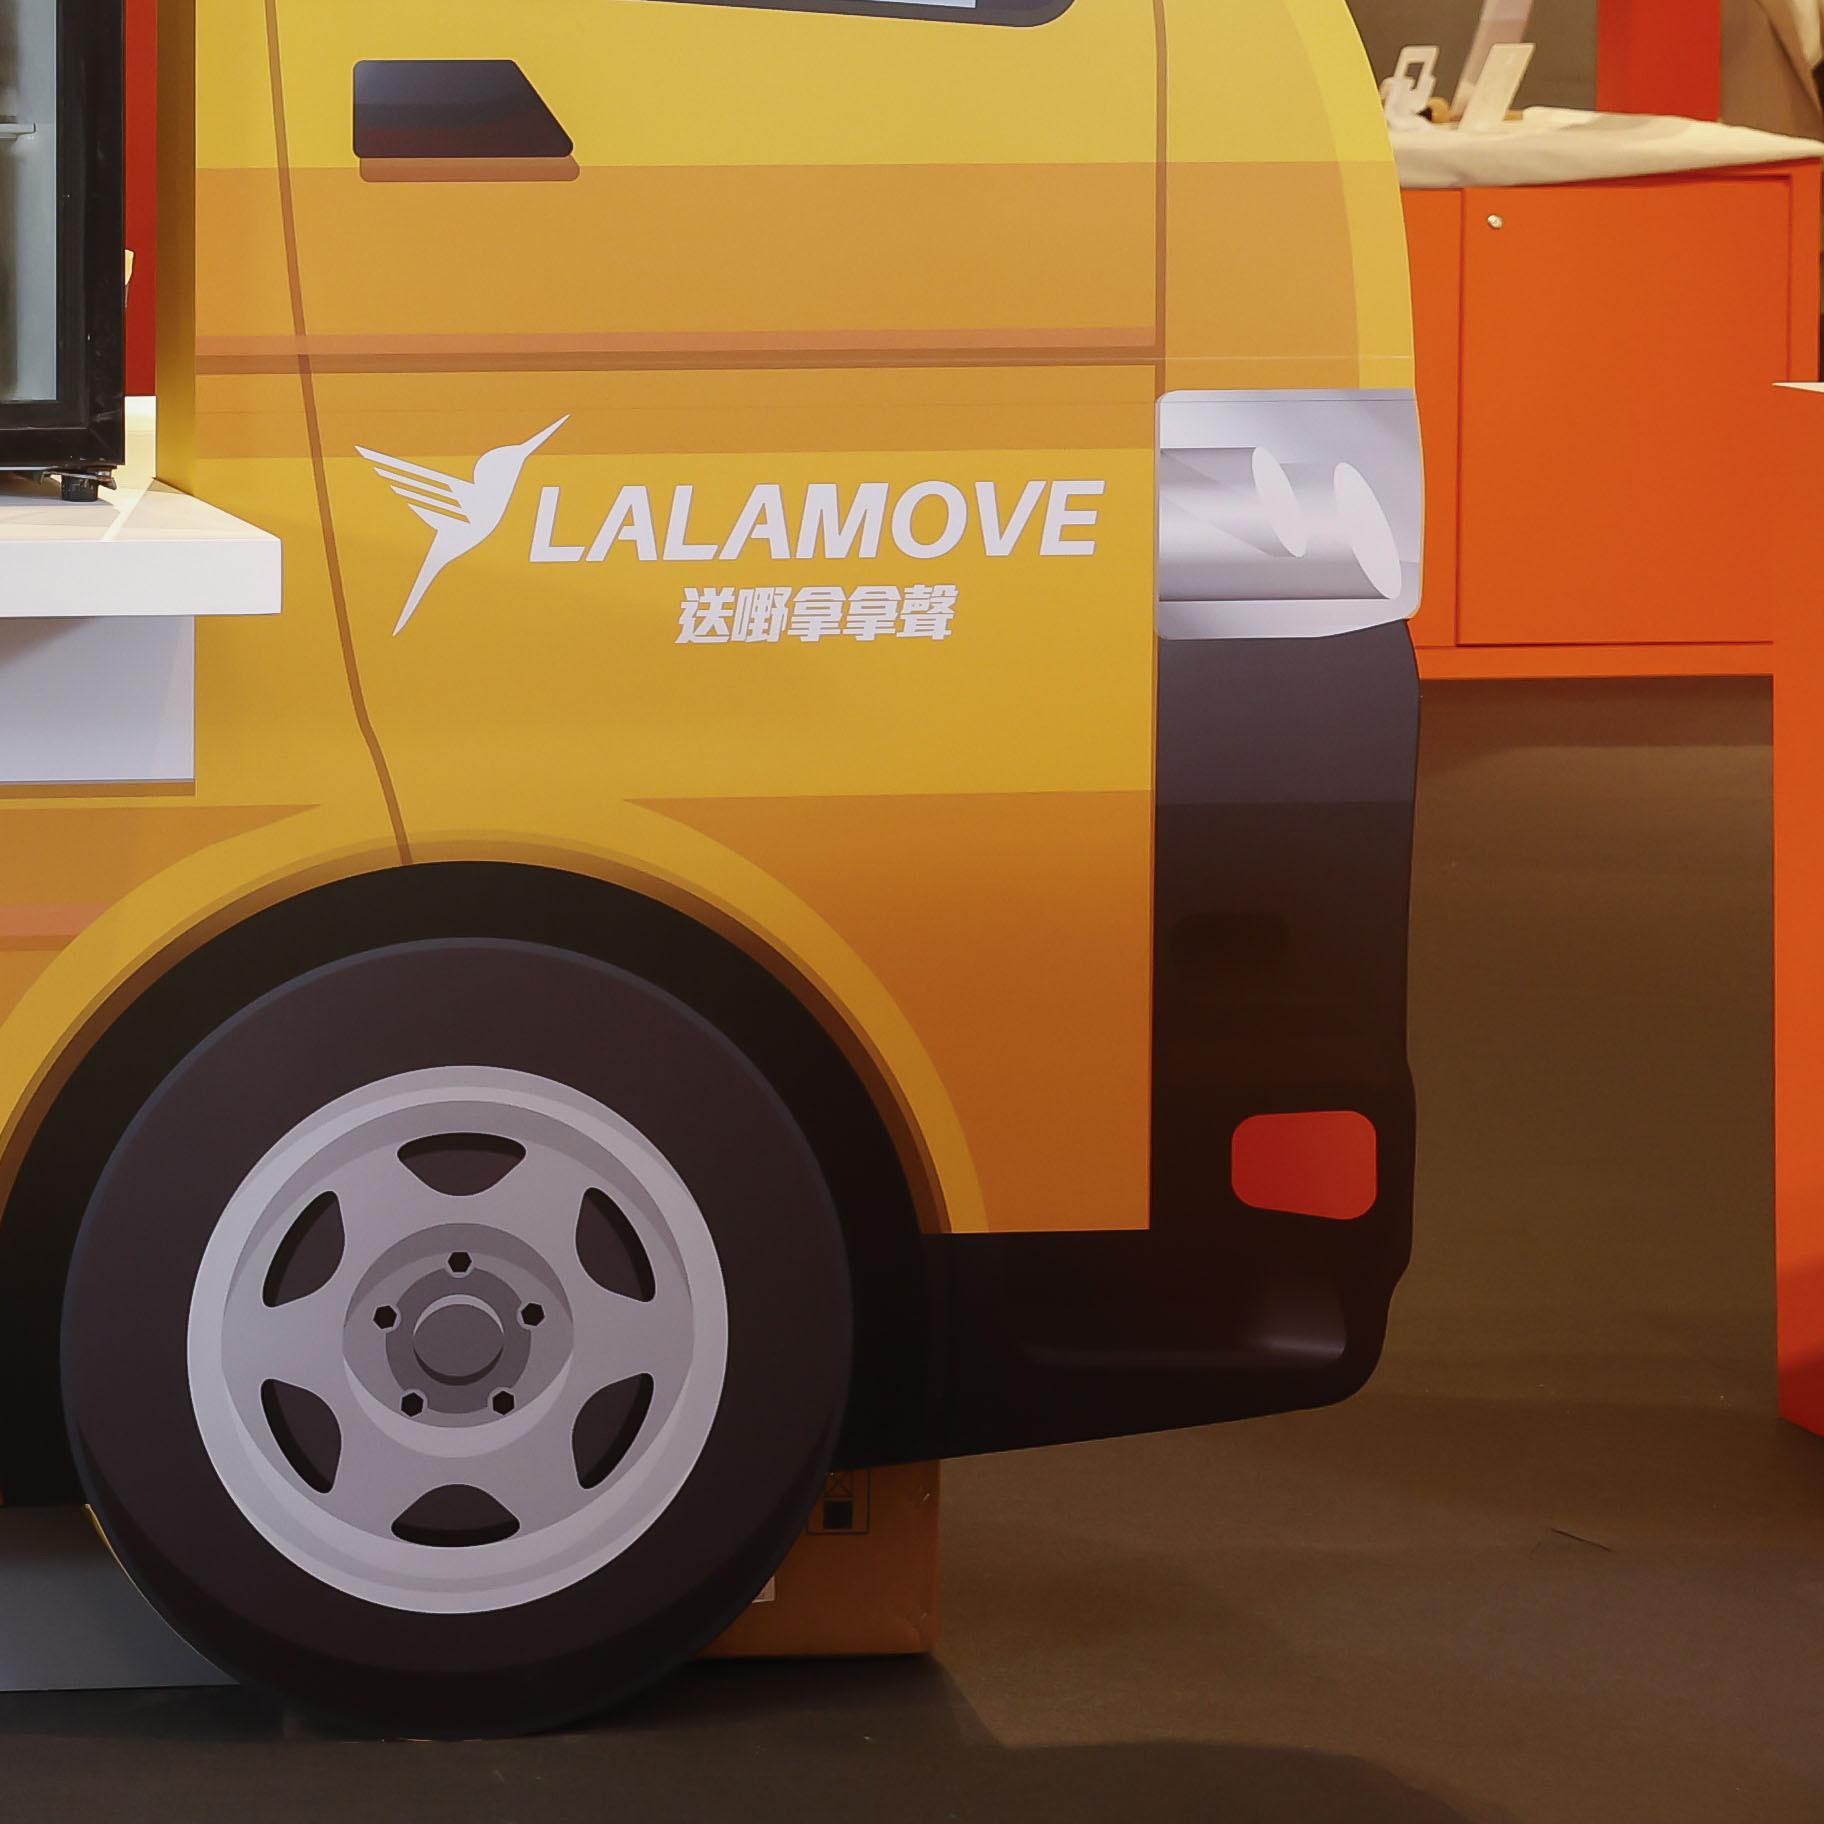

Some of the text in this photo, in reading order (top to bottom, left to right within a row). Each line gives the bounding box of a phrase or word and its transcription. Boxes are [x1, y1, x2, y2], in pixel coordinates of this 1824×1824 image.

[529, 479, 1106, 563] LALAMOVE
[675, 585, 959, 645] 送嘢拿拿聲
